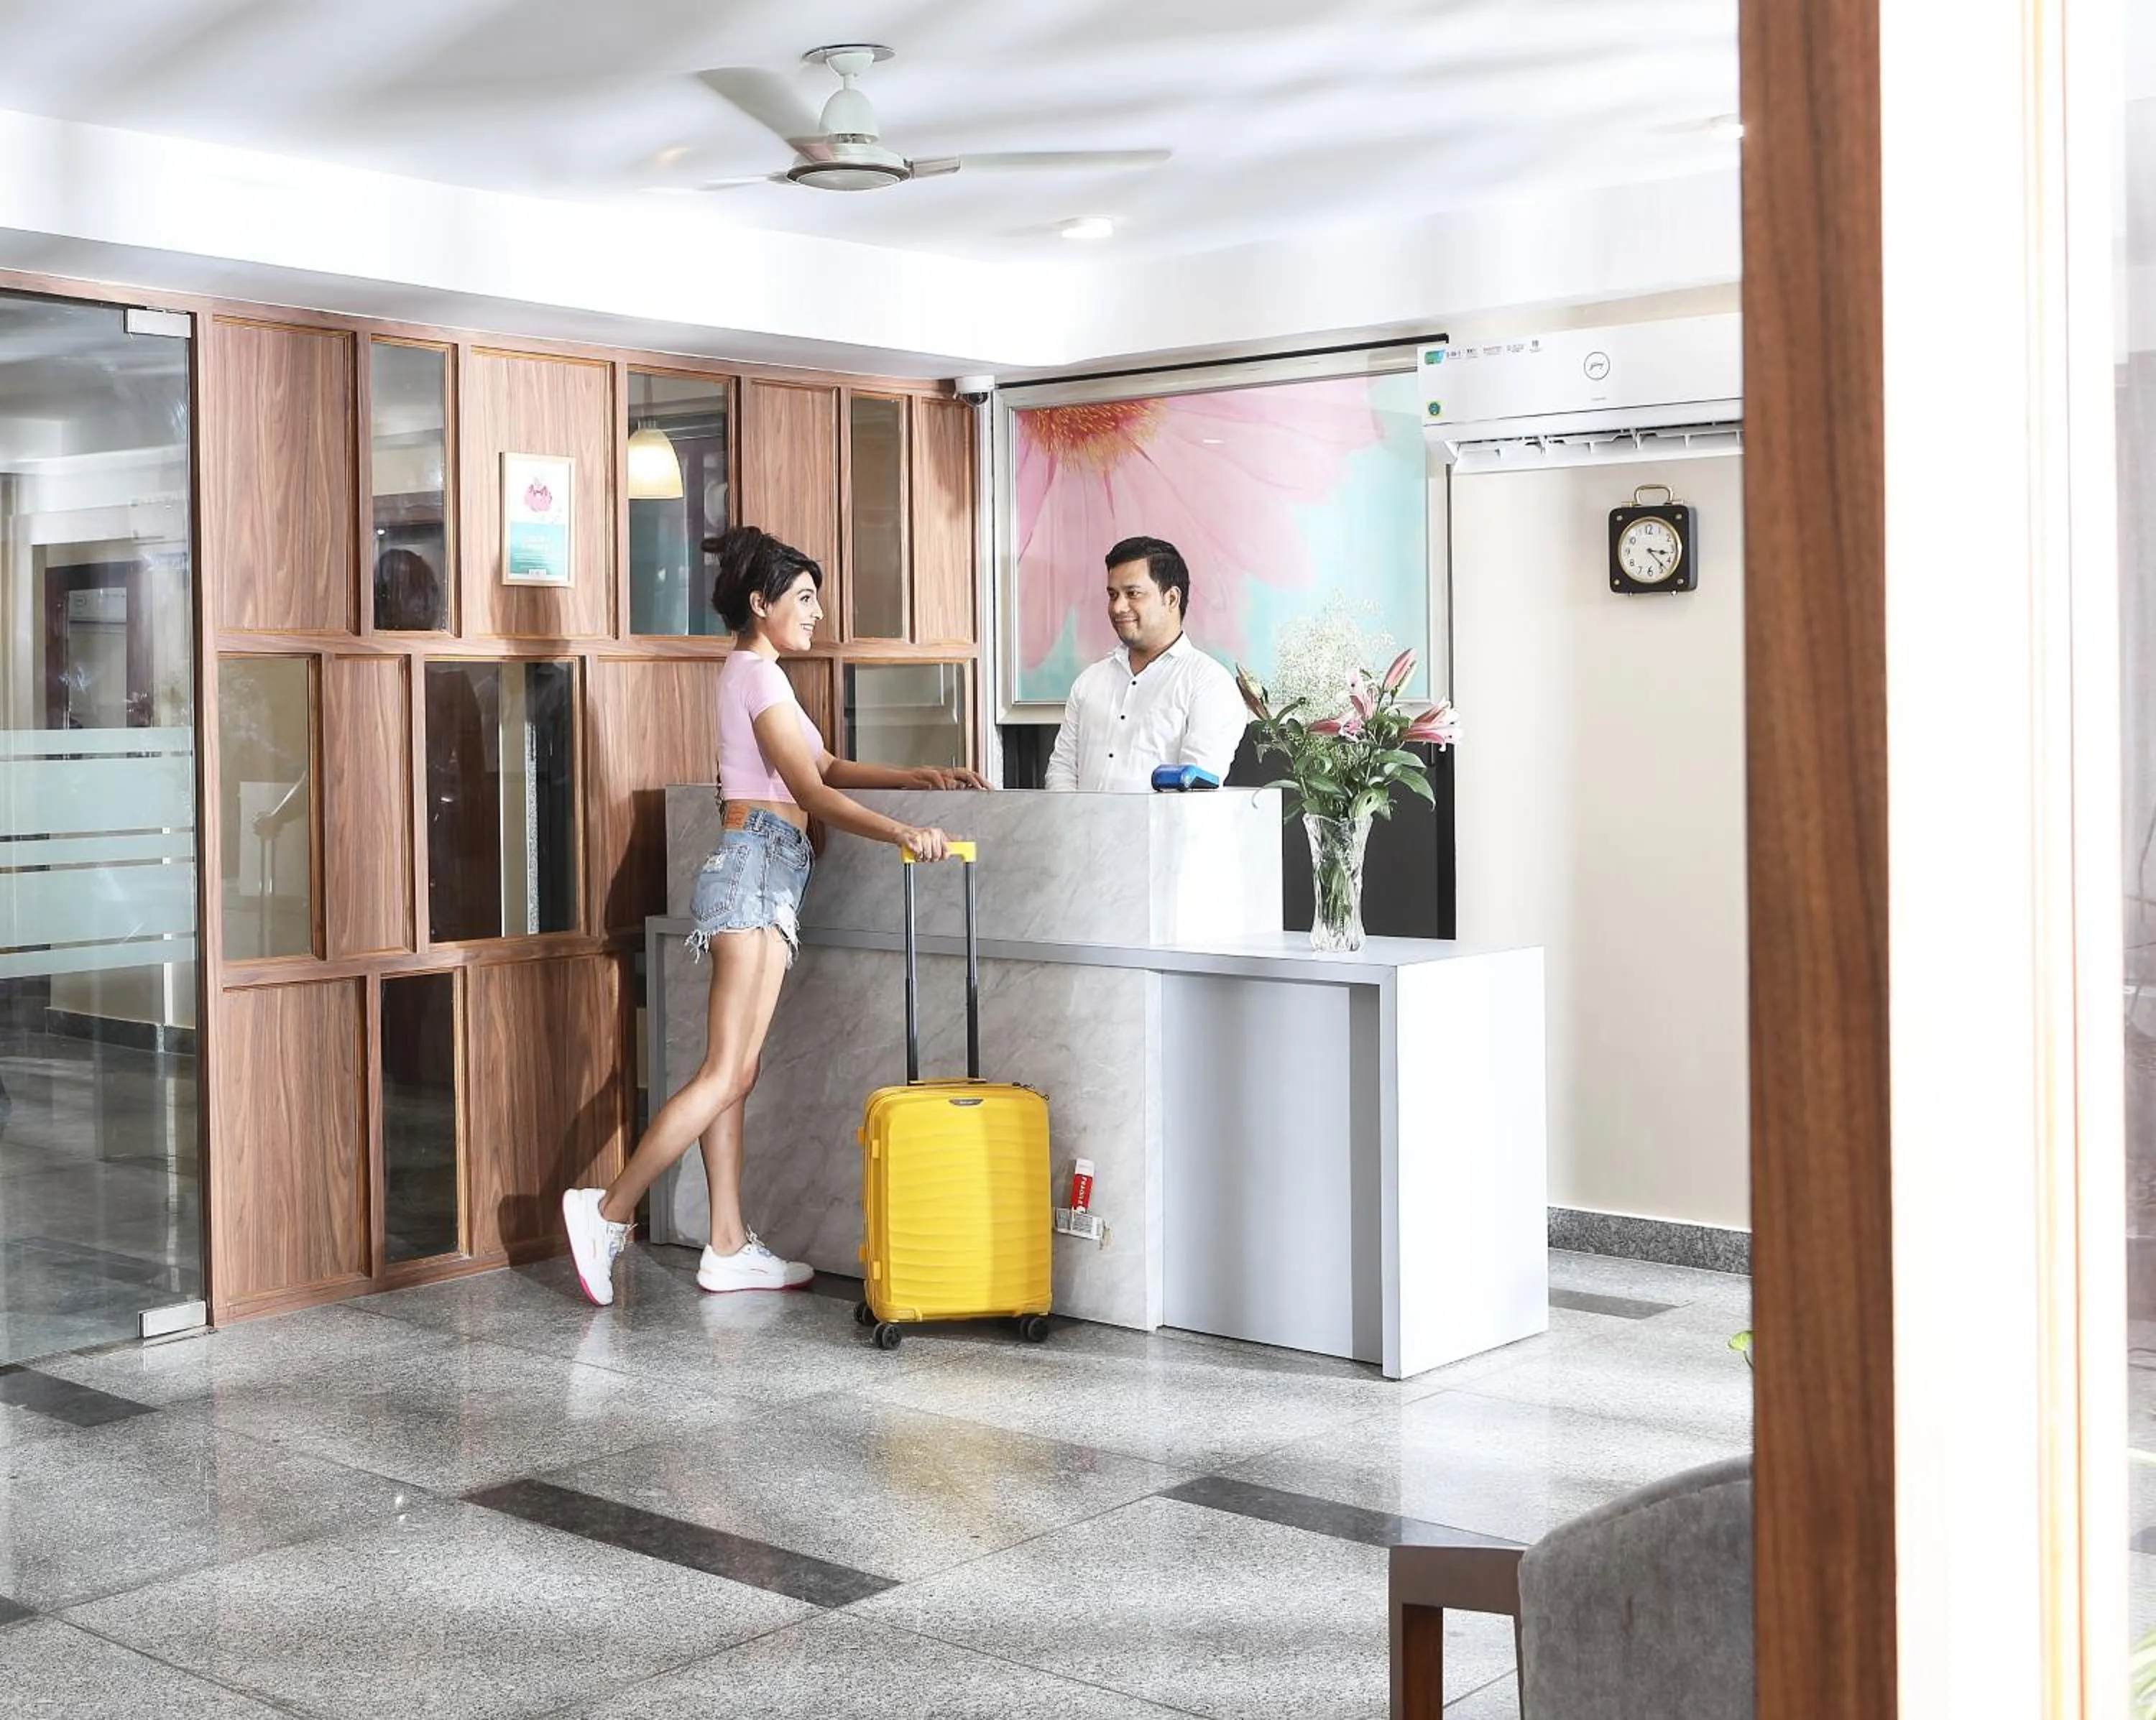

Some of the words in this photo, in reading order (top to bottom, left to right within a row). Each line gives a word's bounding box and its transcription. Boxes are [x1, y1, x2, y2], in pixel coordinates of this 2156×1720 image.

[1645, 524, 1654, 535] 12
[1666, 533, 1672, 542] 2
[1636, 566, 1643, 575] 7
[1647, 565, 1654, 577] 6
